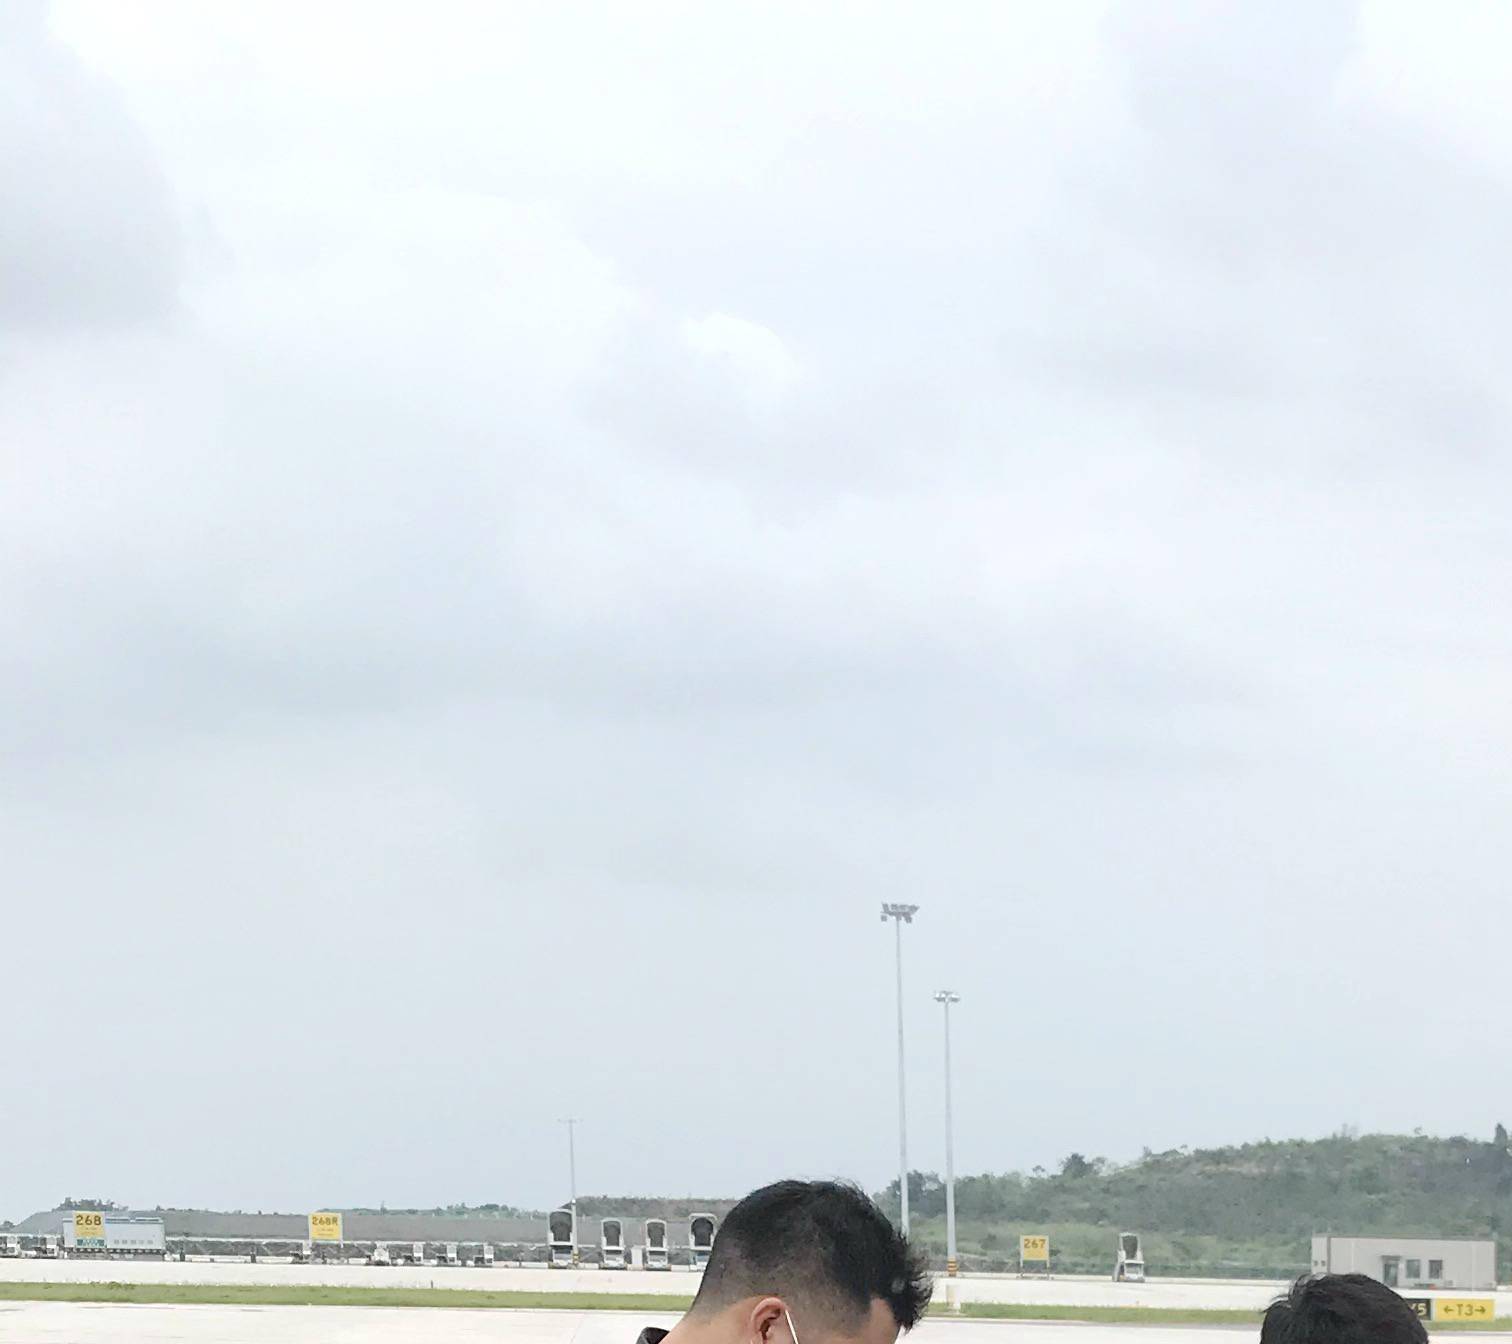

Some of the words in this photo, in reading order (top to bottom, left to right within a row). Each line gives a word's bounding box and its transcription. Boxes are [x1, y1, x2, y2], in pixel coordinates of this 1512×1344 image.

[76, 1215, 102, 1226] 268
[1024, 1238, 1046, 1249] 267
[1456, 1304, 1473, 1316] T3
